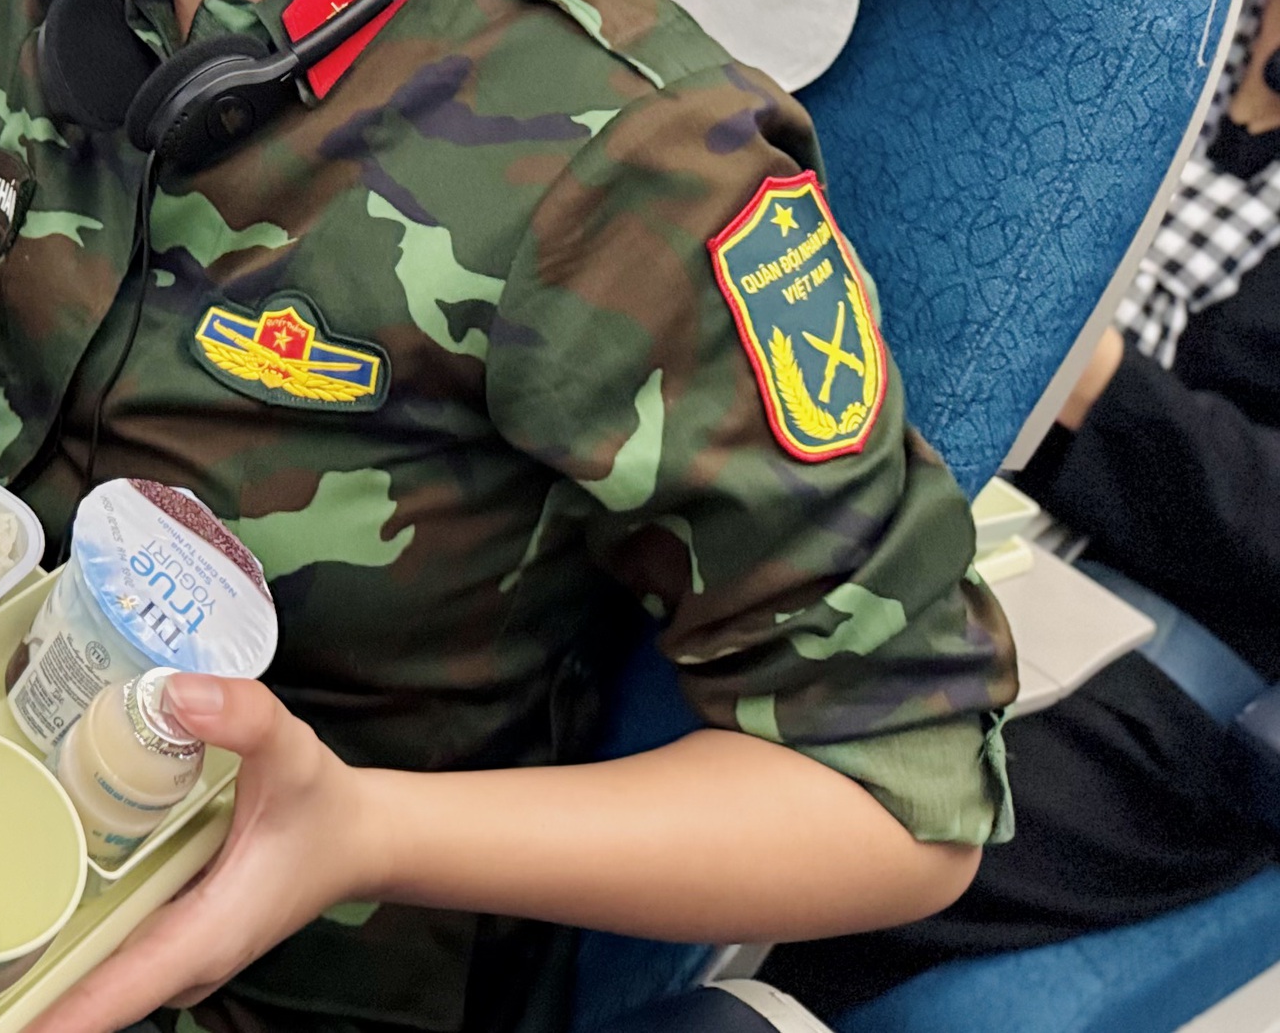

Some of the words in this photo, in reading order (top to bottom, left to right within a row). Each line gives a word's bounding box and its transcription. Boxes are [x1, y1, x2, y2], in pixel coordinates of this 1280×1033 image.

[740, 262, 783, 294] QUÂN
[779, 247, 803, 274] ĐỘI
[781, 274, 812, 305] VIỆT
[810, 258, 834, 287] NAM
[141, 539, 216, 615] YOGURT
[171, 541, 195, 567] Chua
[130, 550, 205, 636] true
[138, 599, 185, 654] TH
